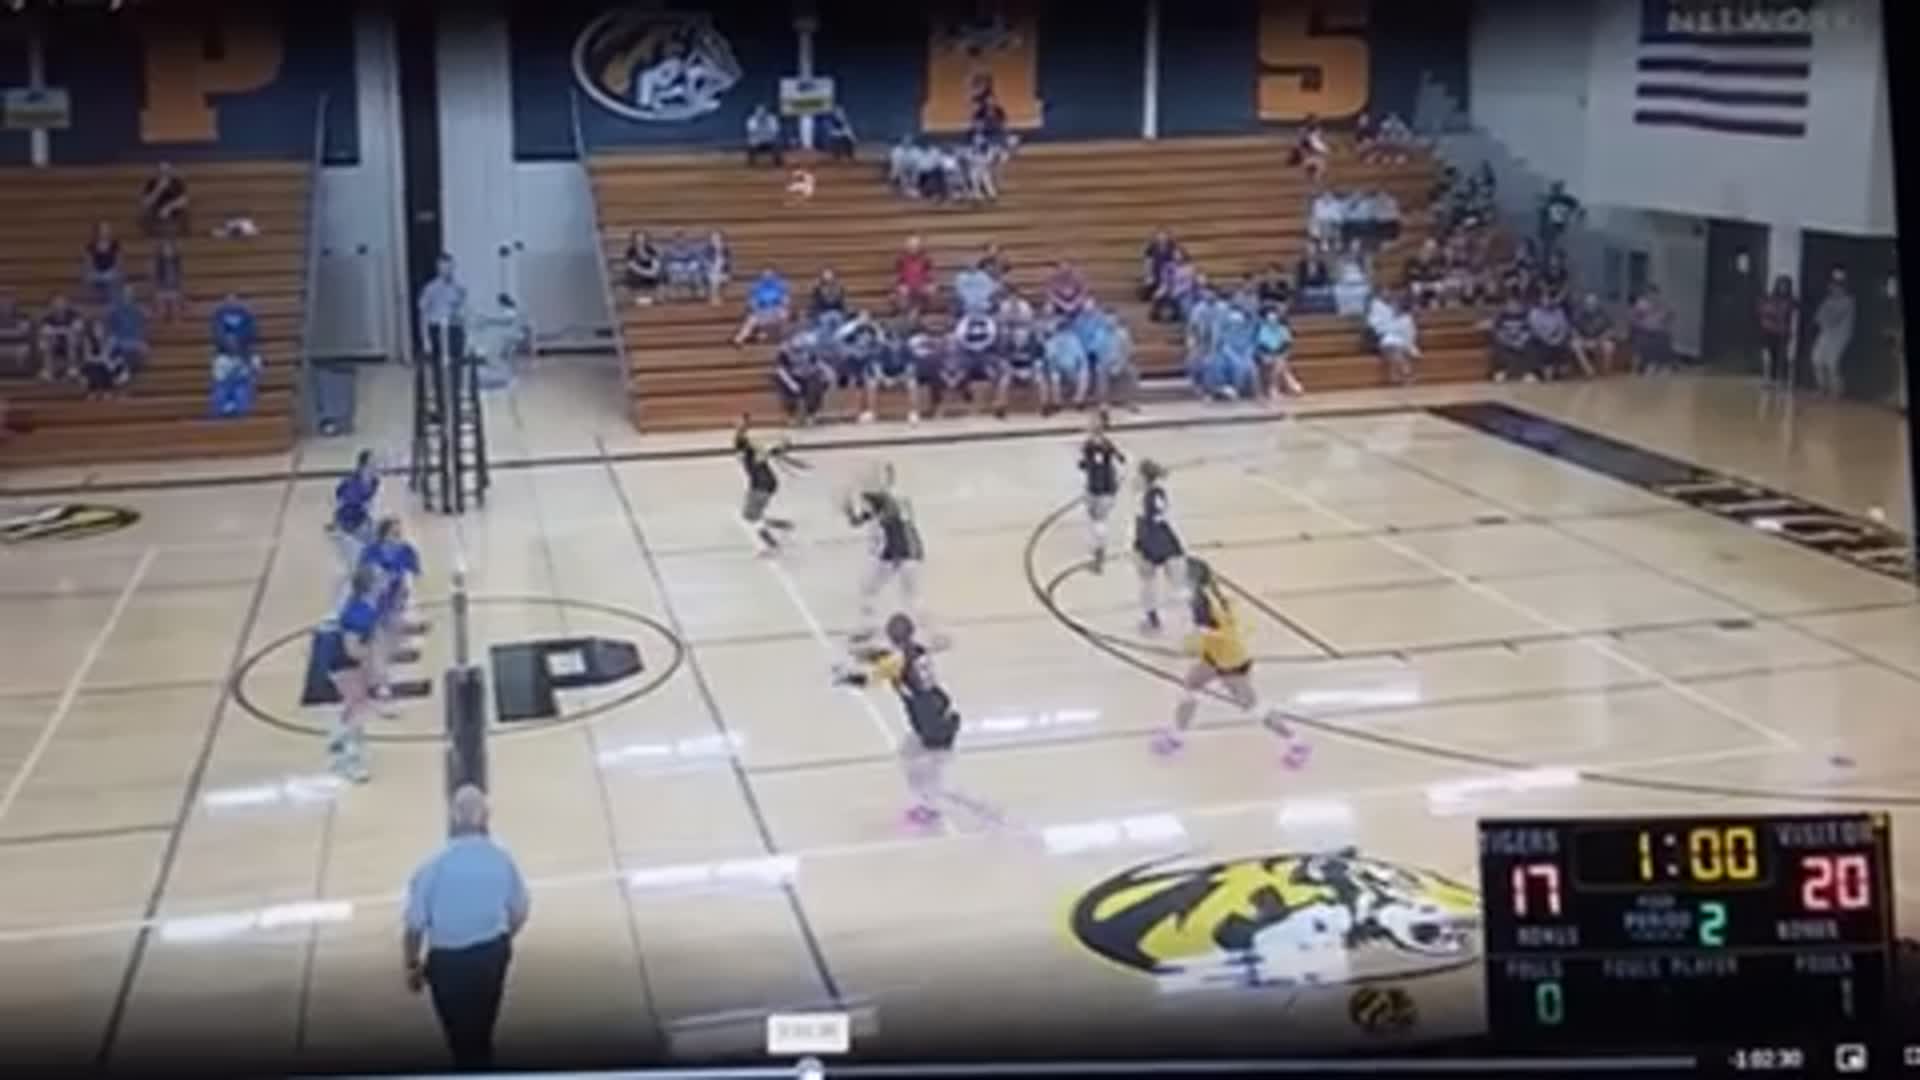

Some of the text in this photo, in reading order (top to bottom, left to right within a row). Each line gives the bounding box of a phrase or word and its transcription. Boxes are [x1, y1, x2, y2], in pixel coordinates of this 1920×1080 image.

[1637, 826, 1758, 881] 1:00
[1512, 864, 1562, 915] 17
[1802, 854, 1871, 911] 20
[1699, 902, 1728, 947] 2
[1536, 981, 1564, 1025] 0
[1840, 975, 1856, 1019] 1
